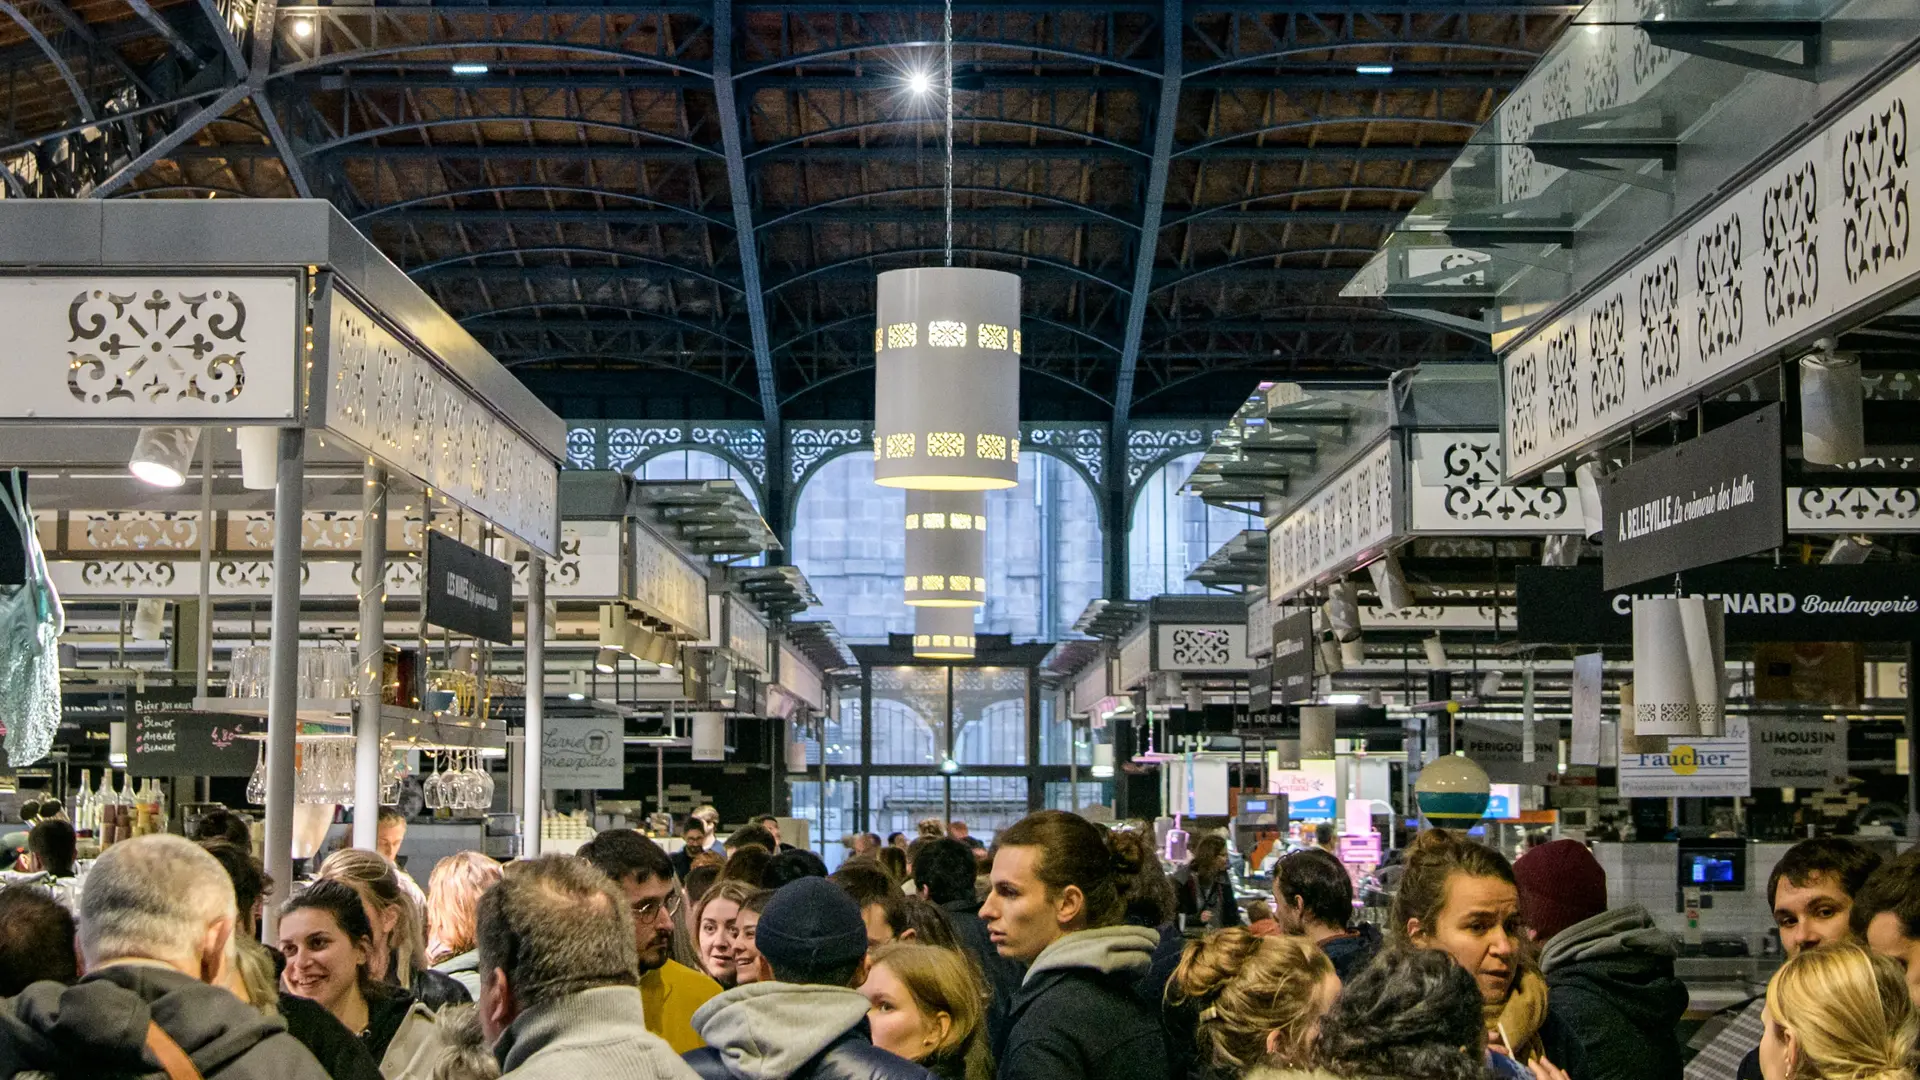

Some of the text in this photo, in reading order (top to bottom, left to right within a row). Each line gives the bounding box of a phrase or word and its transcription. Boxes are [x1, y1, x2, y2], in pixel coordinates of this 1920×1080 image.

[1627, 495, 1672, 539] BELLEVILLE
[1672, 495, 1683, 525] La
[1684, 486, 1716, 522] crèmerie
[1717, 482, 1731, 512] des
[1731, 473, 1755, 507] halles
[1801, 594, 1919, 617] Boulangerie
[1760, 731, 1836, 744] LIMOUSIN
[1470, 740, 1553, 753] PÉRIGOUDIN
[1773, 747, 1823, 756] FONDANT
